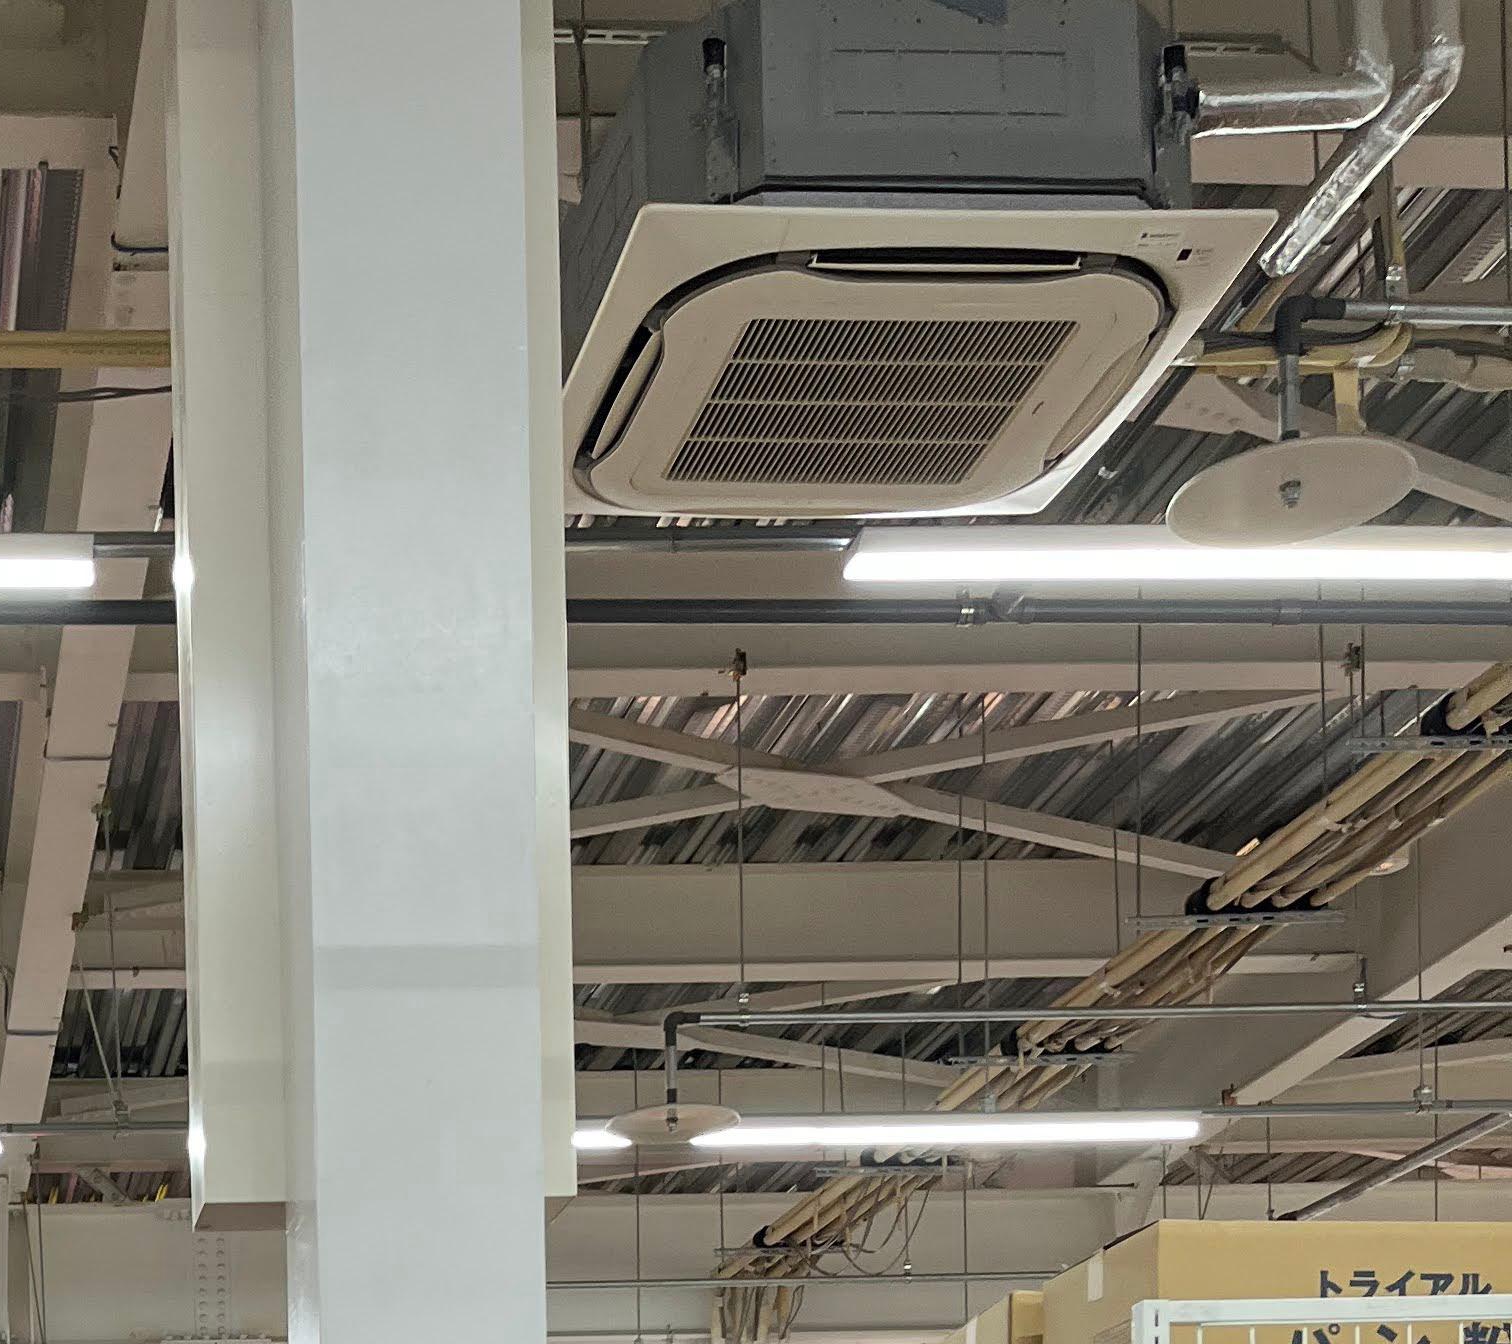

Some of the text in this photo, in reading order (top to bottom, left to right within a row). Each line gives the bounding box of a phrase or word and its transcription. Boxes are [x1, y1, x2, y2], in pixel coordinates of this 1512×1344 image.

[1320, 1270, 1492, 1297] トライアル
